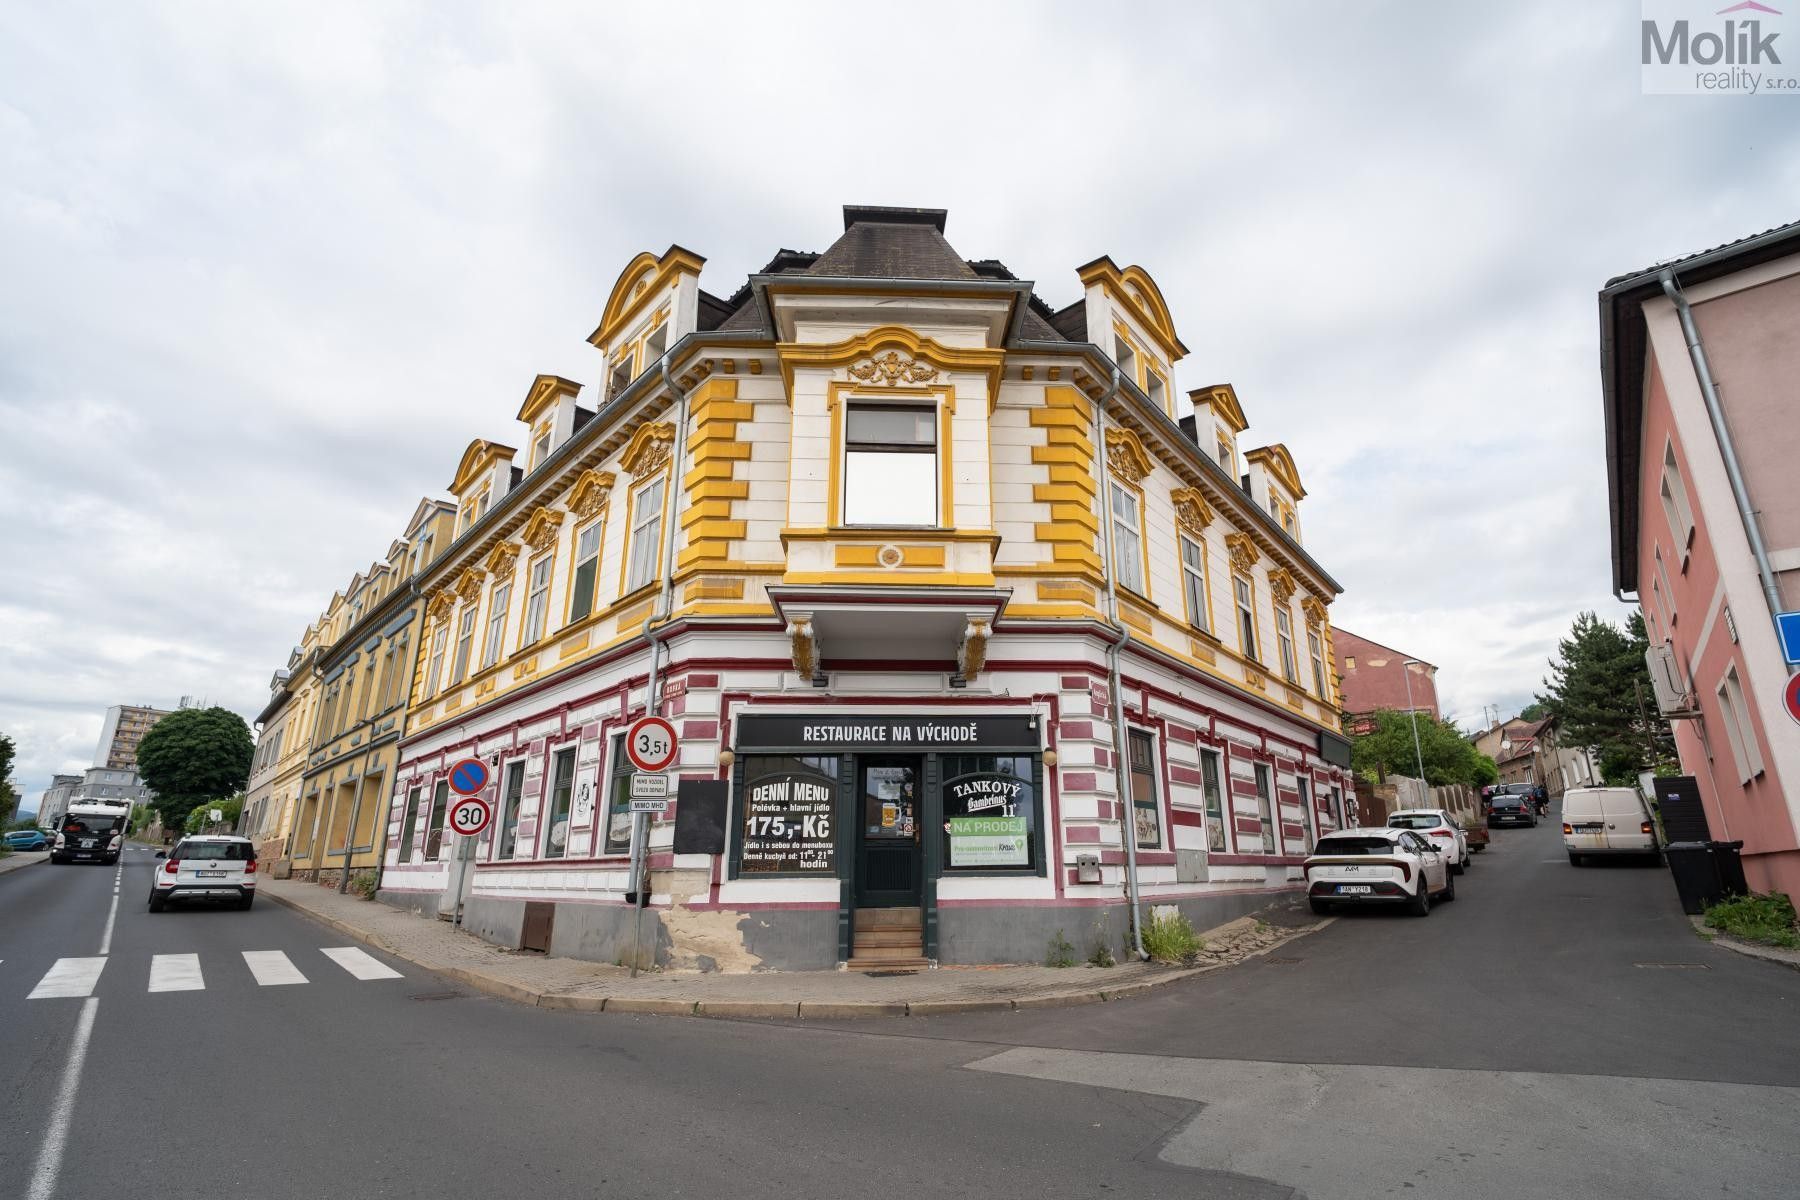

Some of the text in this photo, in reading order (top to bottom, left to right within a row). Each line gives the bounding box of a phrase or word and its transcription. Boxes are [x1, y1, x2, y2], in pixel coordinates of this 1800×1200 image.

[803, 722, 978, 742] RESTAURACE NA VÝCHODĚ
[752, 777, 829, 801] DENNÍ MENU
[953, 780, 1022, 798] TANKOVÝ
[752, 803, 781, 812] Polévka
[789, 803, 812, 812] hlavní
[813, 803, 830, 813] jídlo
[457, 807, 483, 826] 30
[954, 820, 1024, 833] NA PRODEJ
[743, 841, 760, 849] Jídlo
[771, 841, 791, 849] sebou
[791, 841, 800, 849] do
[801, 841, 833, 849] menuboxu
[743, 852, 763, 860] Denně
[800, 859, 828, 868] hodin
